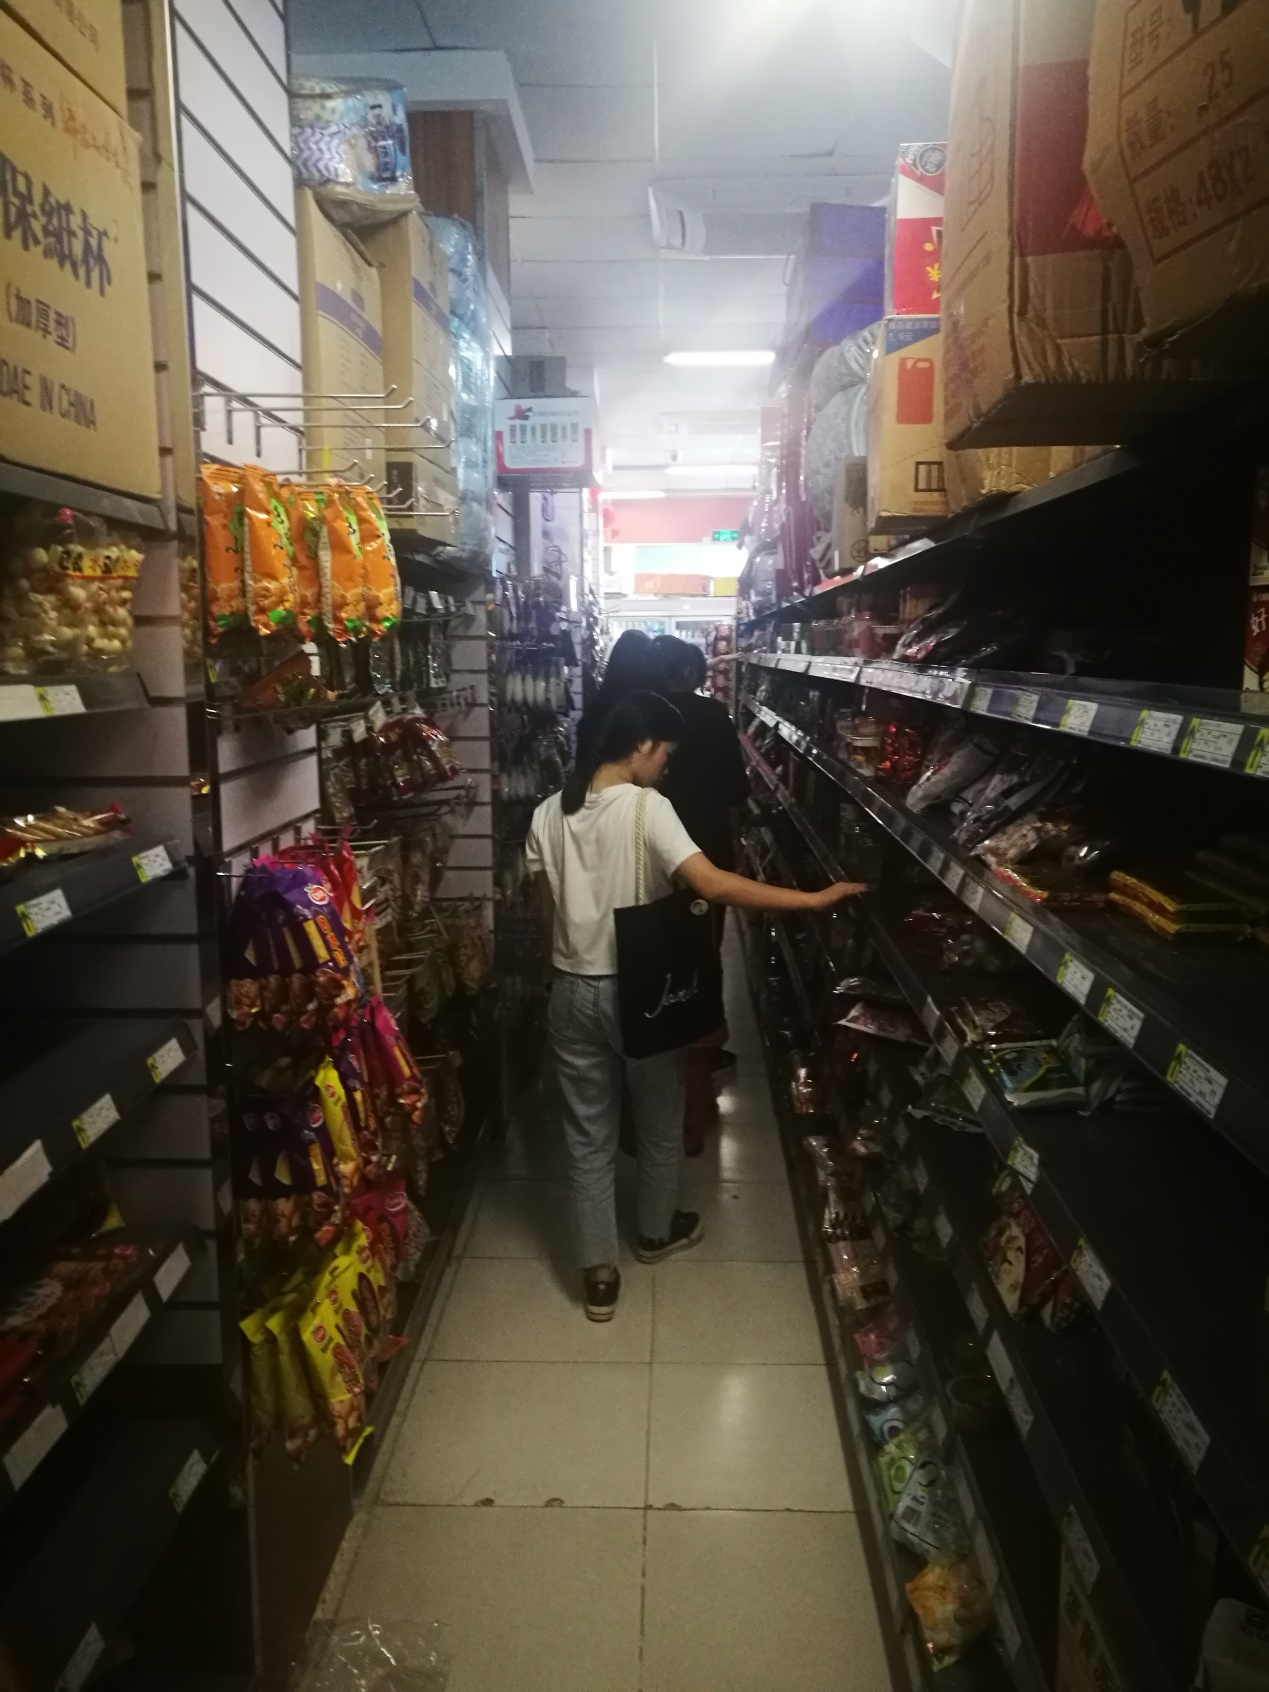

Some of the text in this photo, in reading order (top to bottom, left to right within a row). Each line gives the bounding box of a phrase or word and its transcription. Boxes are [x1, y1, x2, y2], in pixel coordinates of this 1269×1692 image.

[0, 150, 113, 298] 保纸杯
[39, 372, 55, 416] IN
[58, 381, 99, 433] CHINA
